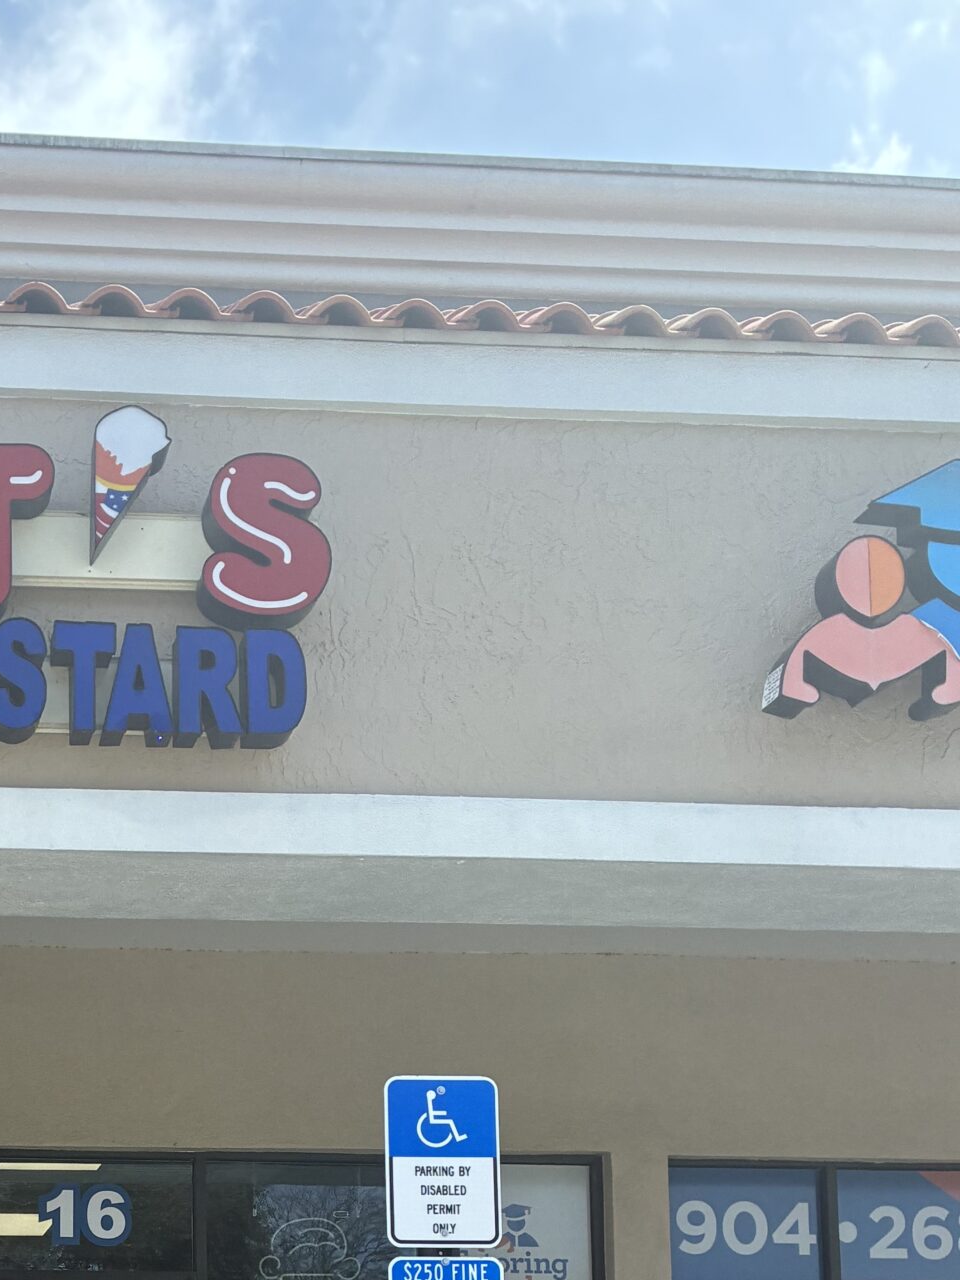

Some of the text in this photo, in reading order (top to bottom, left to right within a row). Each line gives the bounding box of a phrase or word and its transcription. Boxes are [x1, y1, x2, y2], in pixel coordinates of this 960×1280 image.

[415, 1165, 471, 1177] PARKING BY
[420, 1184, 467, 1196] DISABLED
[46, 1189, 126, 1239] 16
[426, 1203, 461, 1215] PERMIT
[432, 1222, 456, 1235] ONLY
[675, 1200, 817, 1256] 904
[484, 1250, 569, 1280] oring
